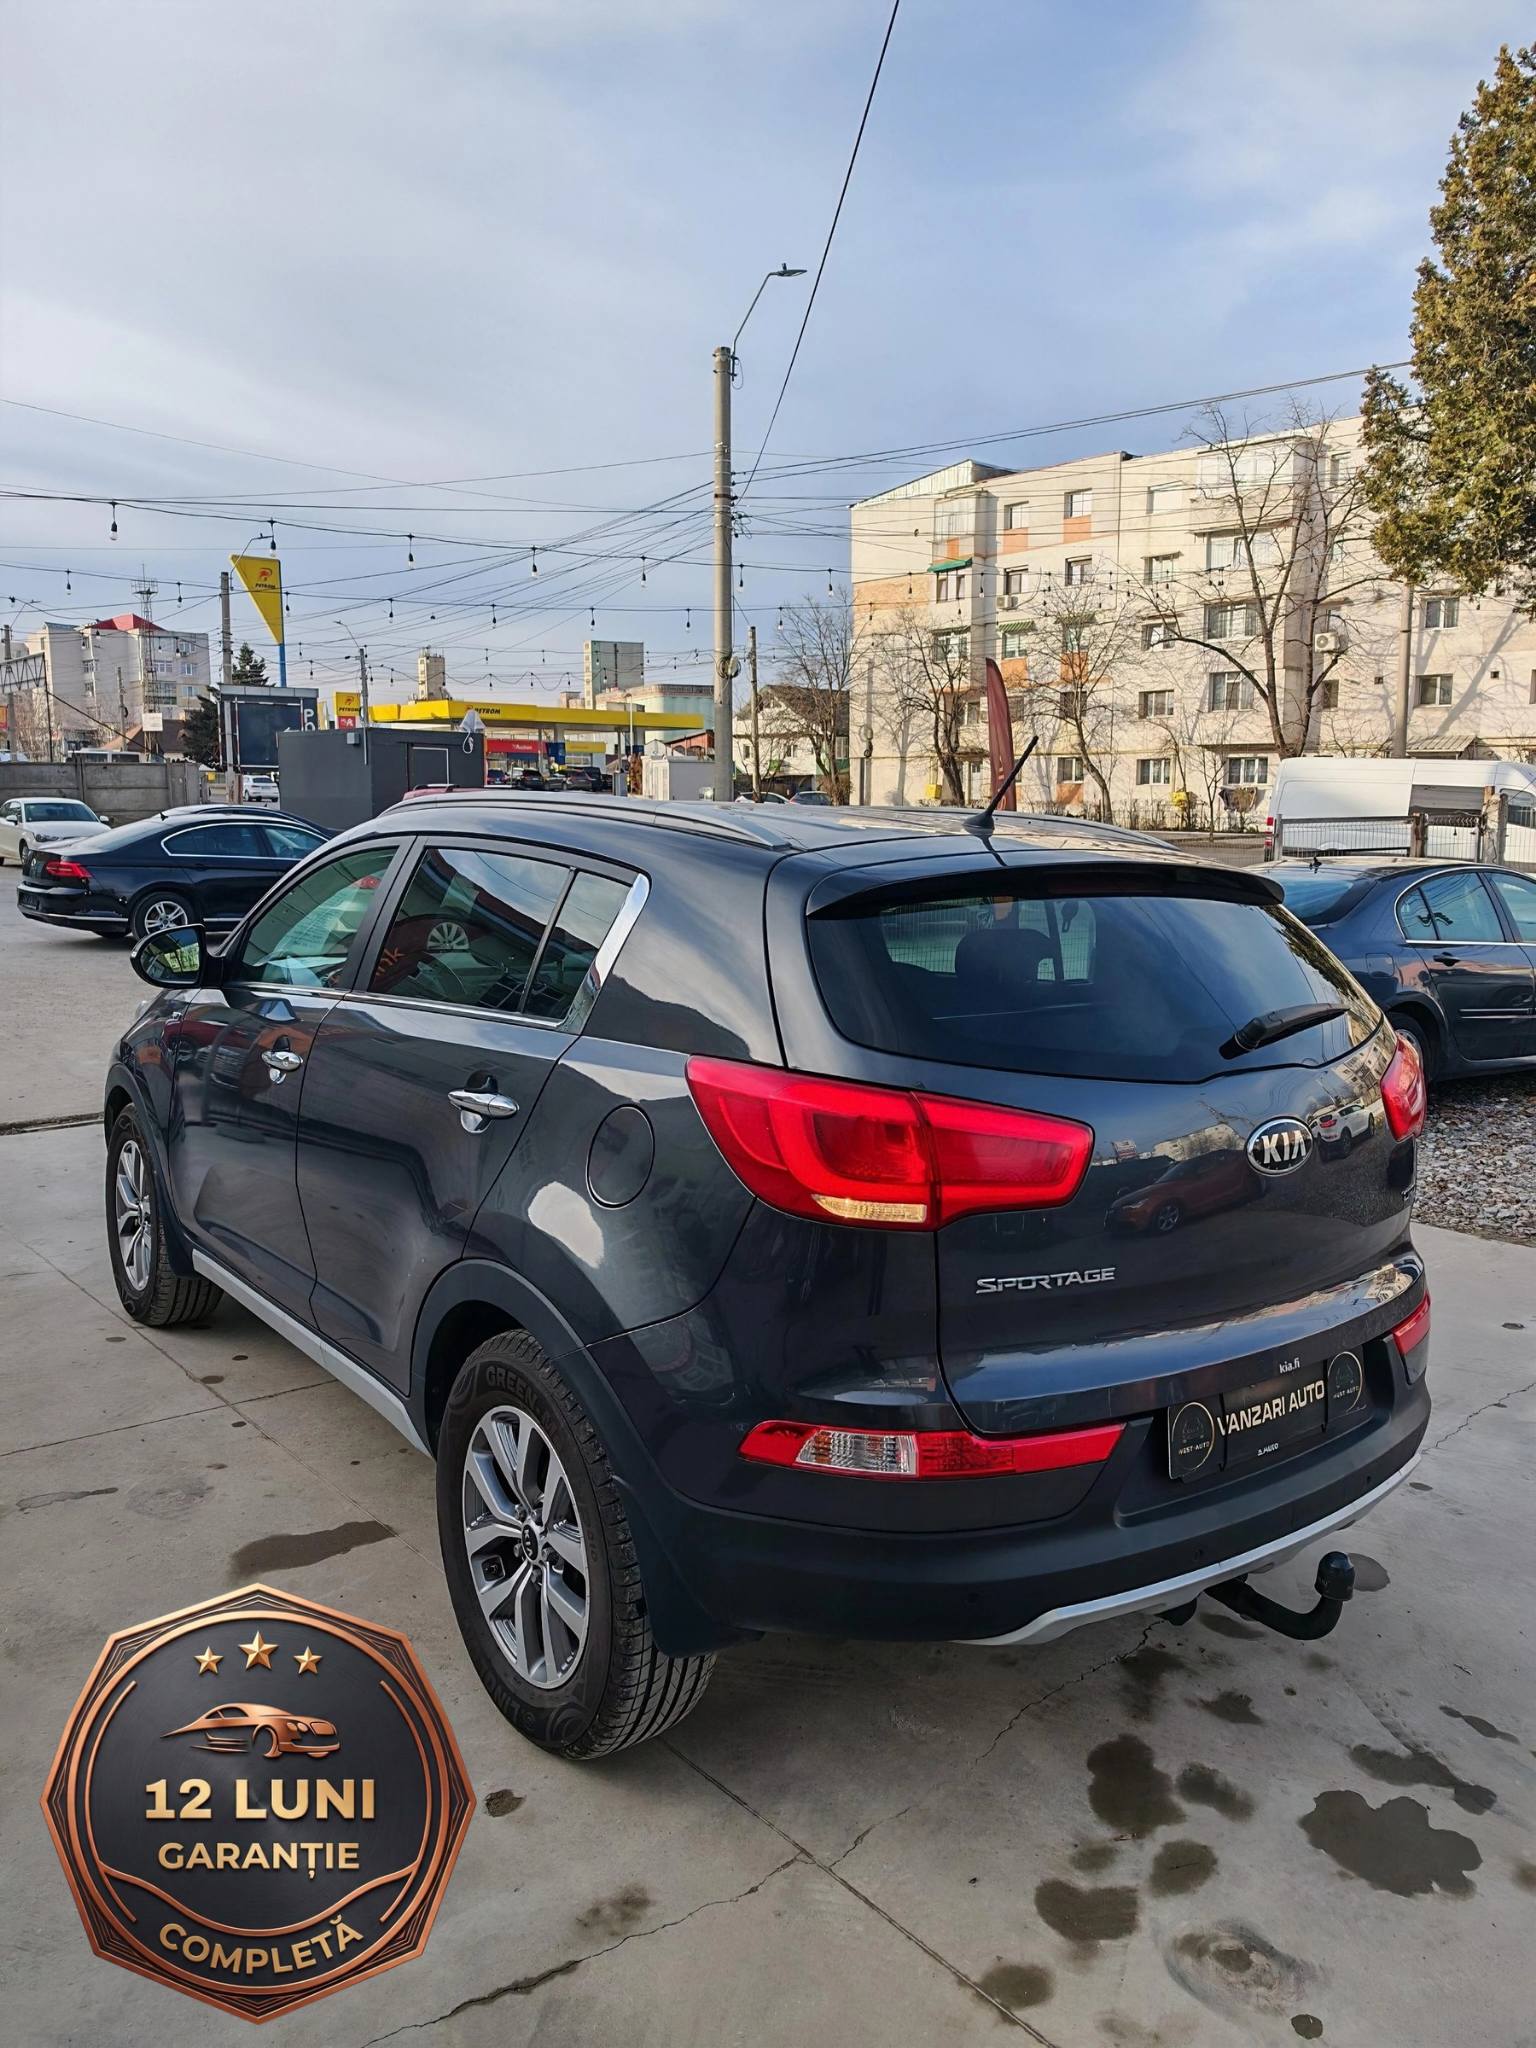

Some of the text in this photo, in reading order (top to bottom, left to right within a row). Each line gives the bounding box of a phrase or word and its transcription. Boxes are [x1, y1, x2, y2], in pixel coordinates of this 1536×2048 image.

[1261, 1129, 1308, 1165] KIA
[975, 1267, 1116, 1295] SPORTAGE
[1279, 1357, 1301, 1374] kia.fi
[1216, 1379, 1325, 1436] VANZARI AUTO
